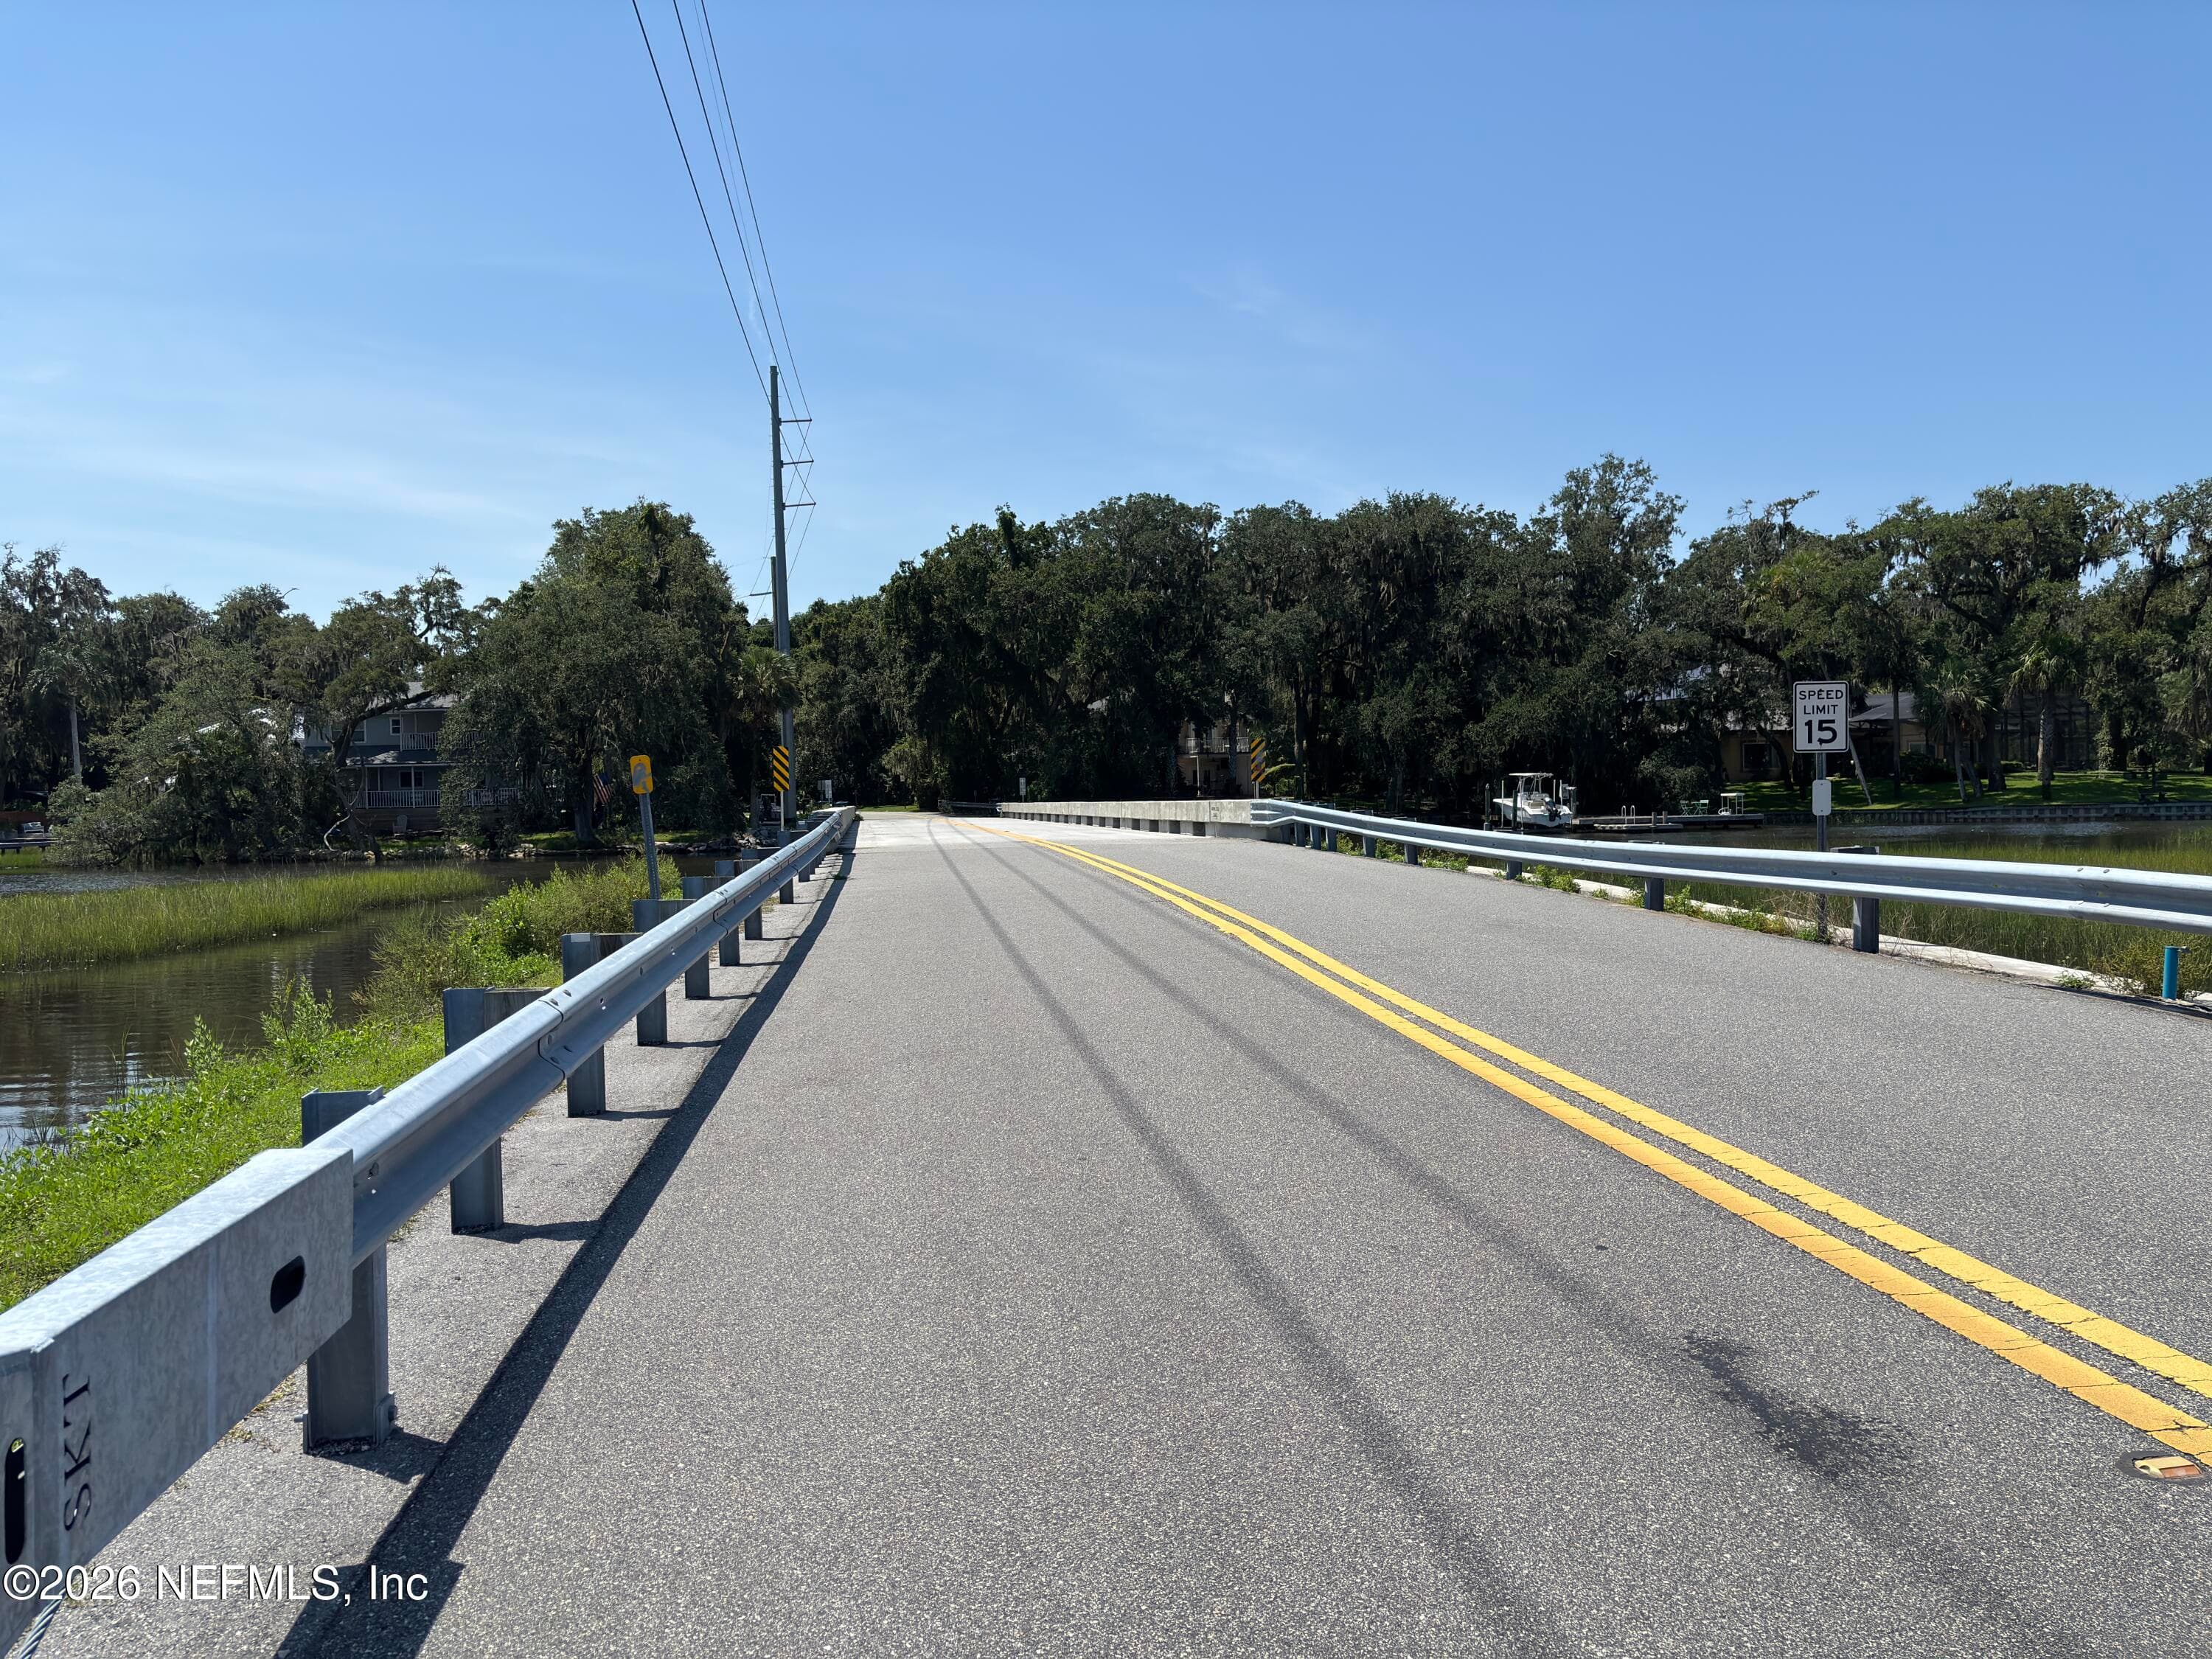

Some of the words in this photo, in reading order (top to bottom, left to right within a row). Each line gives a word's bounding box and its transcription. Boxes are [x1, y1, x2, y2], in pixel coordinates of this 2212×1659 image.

[1798, 689, 1843, 700] SPEED
[1804, 704, 1838, 714] LIMIT
[1804, 719, 1837, 744] 15
